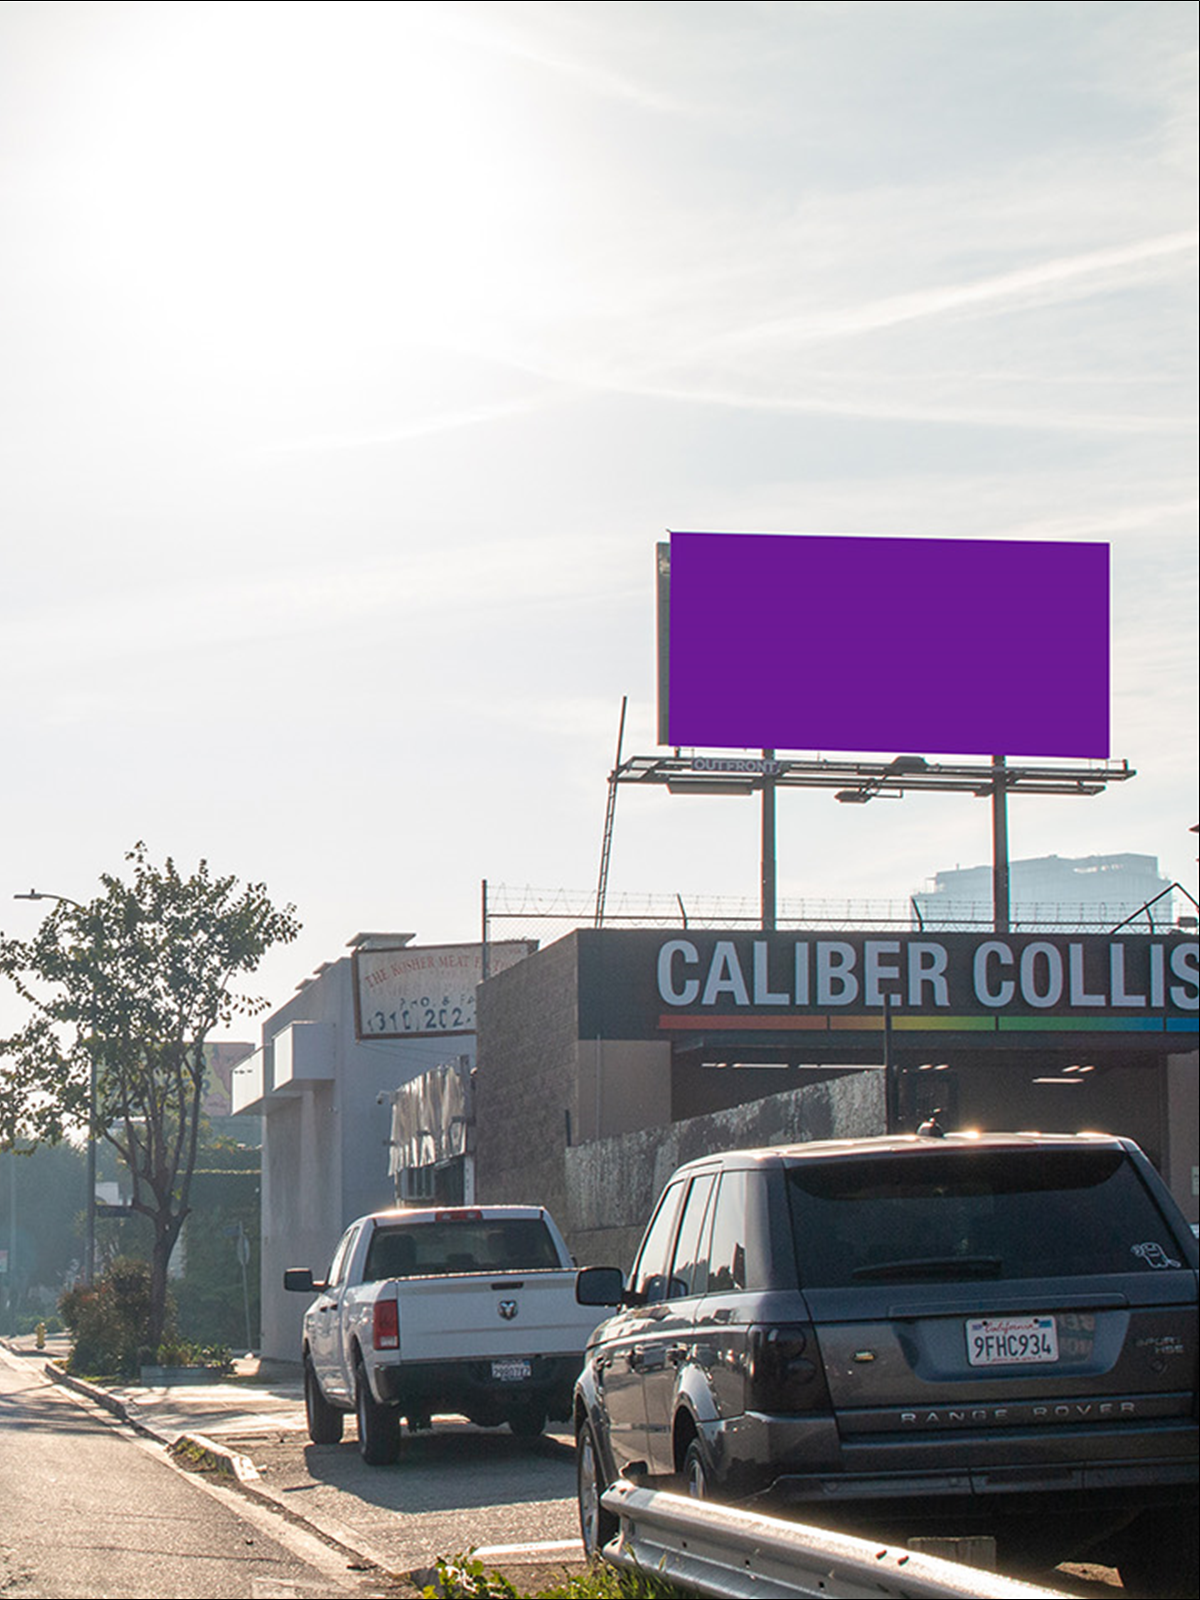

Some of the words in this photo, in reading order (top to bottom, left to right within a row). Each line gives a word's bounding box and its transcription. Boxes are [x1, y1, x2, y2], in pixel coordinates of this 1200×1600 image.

[657, 940, 950, 1007] CALIBER
[973, 942, 1198, 1008] COLLIS
[973, 1333, 1051, 1358] 9FHC934
[900, 1409, 1008, 1423] RANGE
[1032, 1402, 1135, 1416] ROVER
